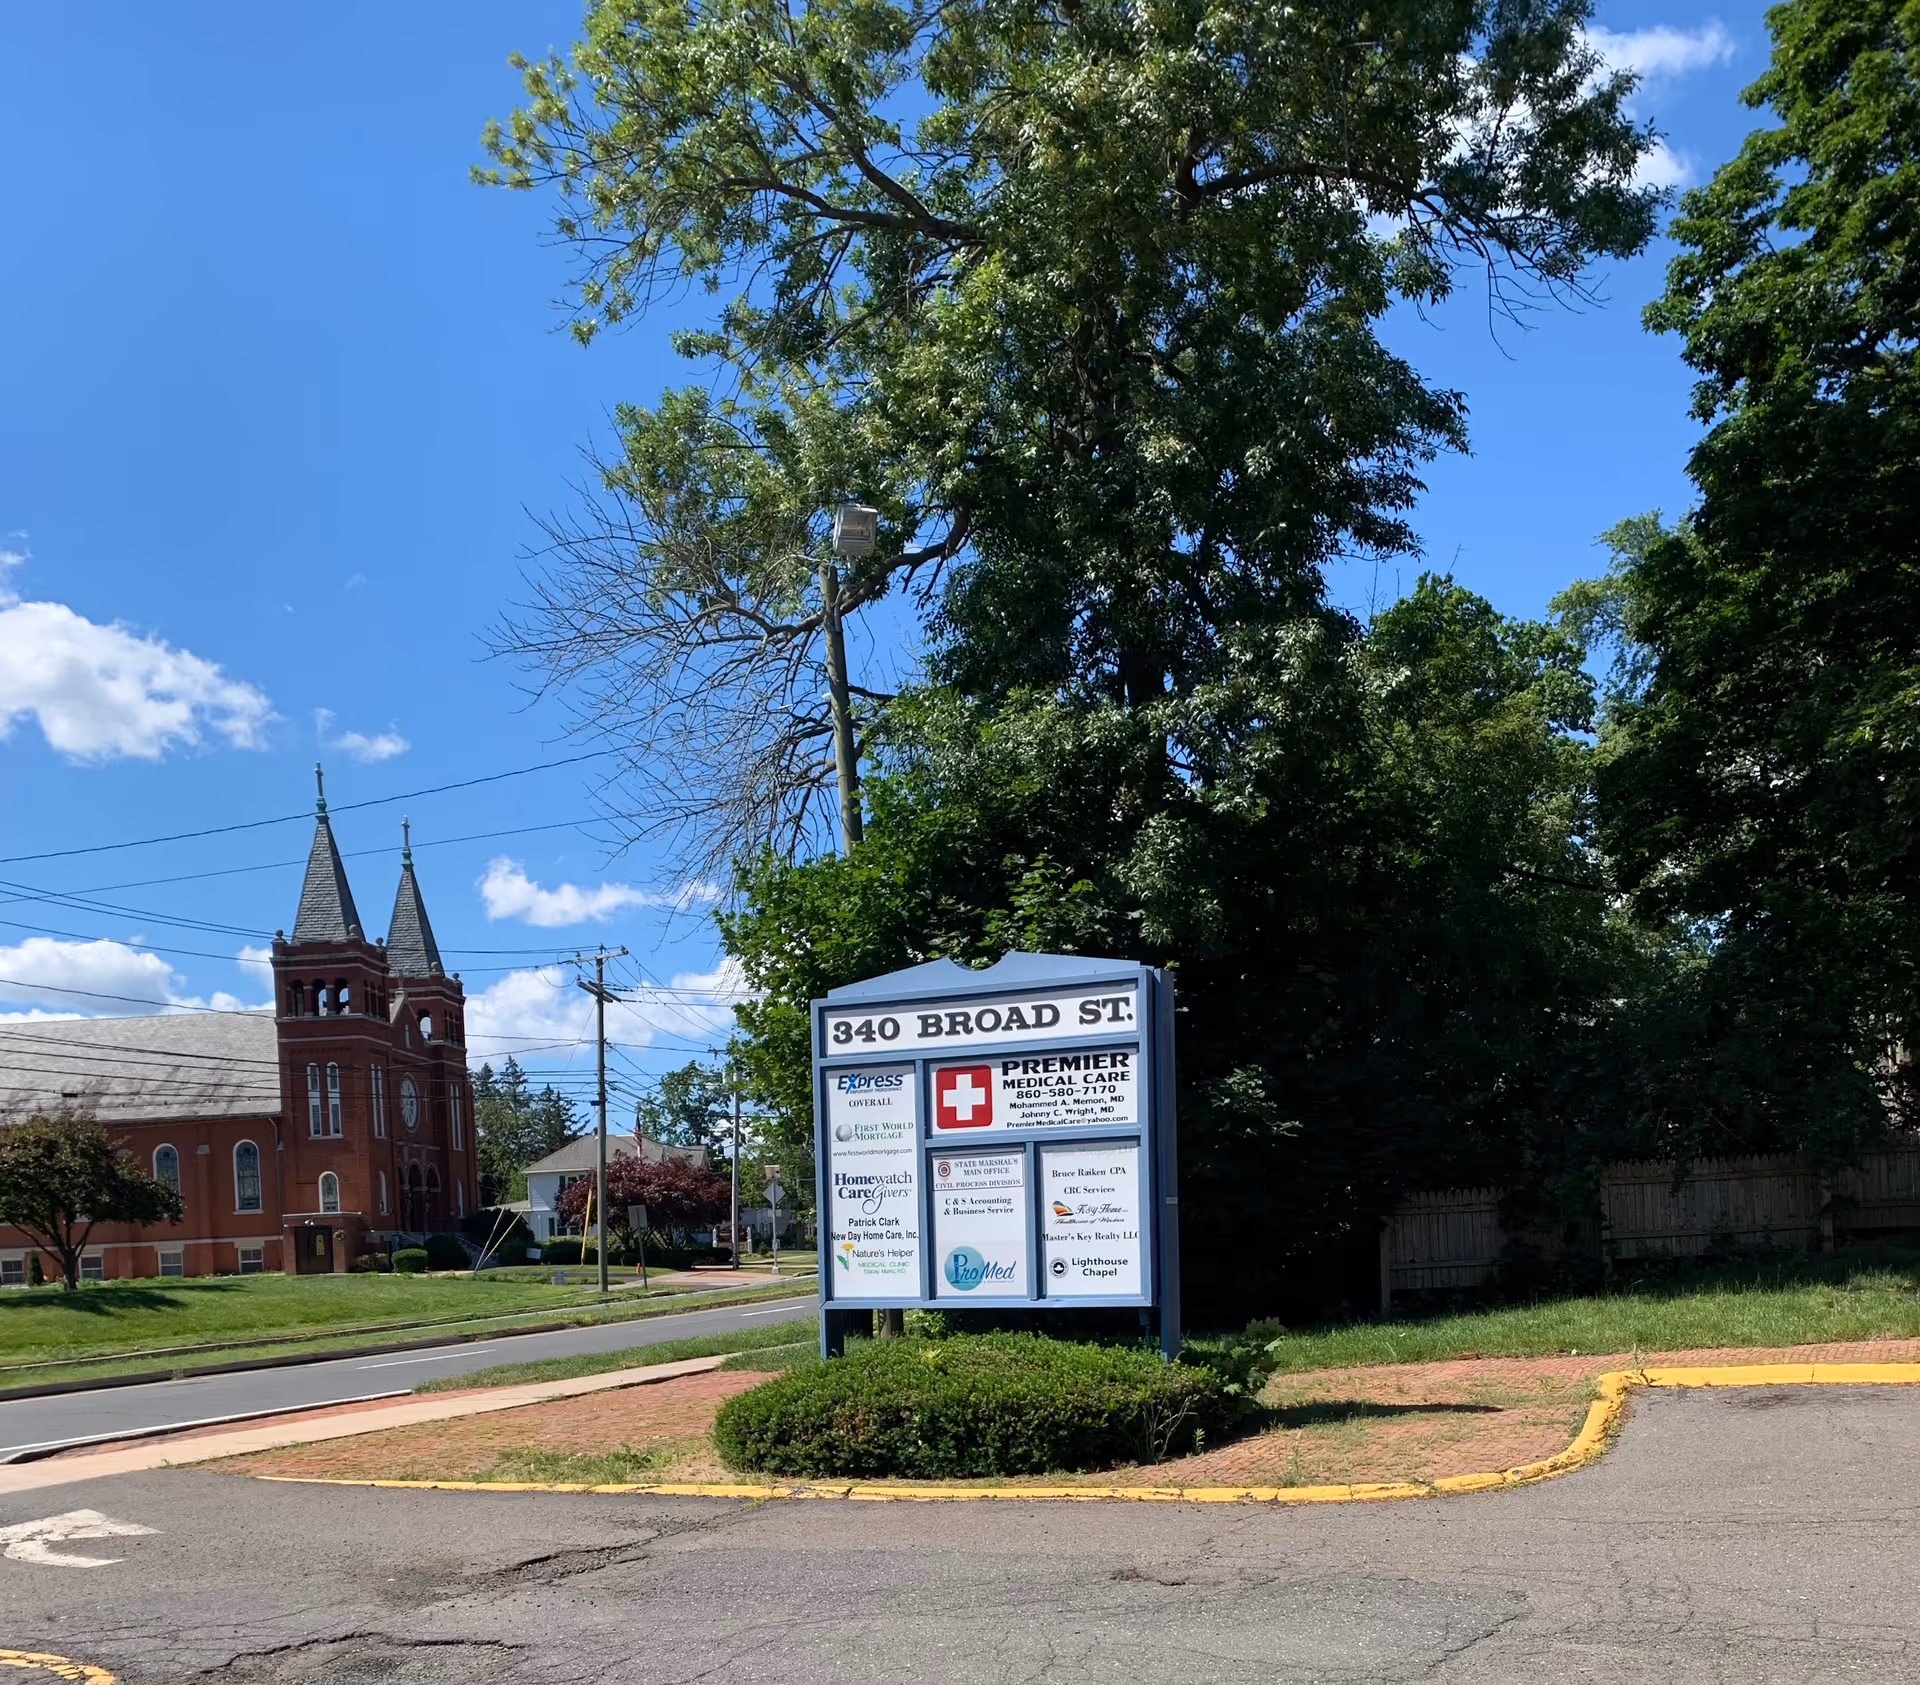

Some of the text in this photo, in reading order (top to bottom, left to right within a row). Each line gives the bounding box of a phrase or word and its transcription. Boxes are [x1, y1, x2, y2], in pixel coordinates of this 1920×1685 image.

[832, 996, 1134, 1044] 340 BROAD ST.
[1001, 1052, 1130, 1076] PREMIER
[837, 1073, 904, 1095] Express
[1002, 1070, 1131, 1090] MEDICAL CARE
[1016, 1085, 1117, 1099] 860-580-7170
[848, 1097, 893, 1108] COVERALL
[1009, 1099, 1058, 1110] Mohammed
[1073, 1097, 1108, 1107] Memon,
[1110, 1095, 1125, 1103] MD
[1019, 1105, 1115, 1119] Johnny C. Wright, MD
[854, 1121, 914, 1132] FIRST WORLD
[854, 1131, 904, 1141] MORTGAGE
[832, 1147, 913, 1158] www.firstworldmortgage.com
[954, 1158, 1019, 1169] STATE MARSHAL'S
[963, 1167, 1010, 1176] MAIN OFFICE
[1052, 1169, 1076, 1178] Bruce
[1109, 1166, 1127, 1175] CPA
[834, 1170, 912, 1186] Homewatch
[935, 1178, 1021, 1189] CIVIL PROCESS DIVISION
[1063, 1185, 1116, 1195] CRC Services
[838, 1184, 910, 1215] CareGivers
[945, 1196, 1012, 1207] C & S Accounting
[943, 1205, 1015, 1216] & Business Service
[848, 1217, 900, 1227] Patrick Clark
[831, 1230, 919, 1243] New Day Home Care, Inc.
[1041, 1231, 1140, 1243] Master's Key Realty LLC
[852, 1248, 915, 1259] Nature's Helper
[1071, 1257, 1129, 1267] Lighthouse
[1082, 1268, 1118, 1278] Chapel
